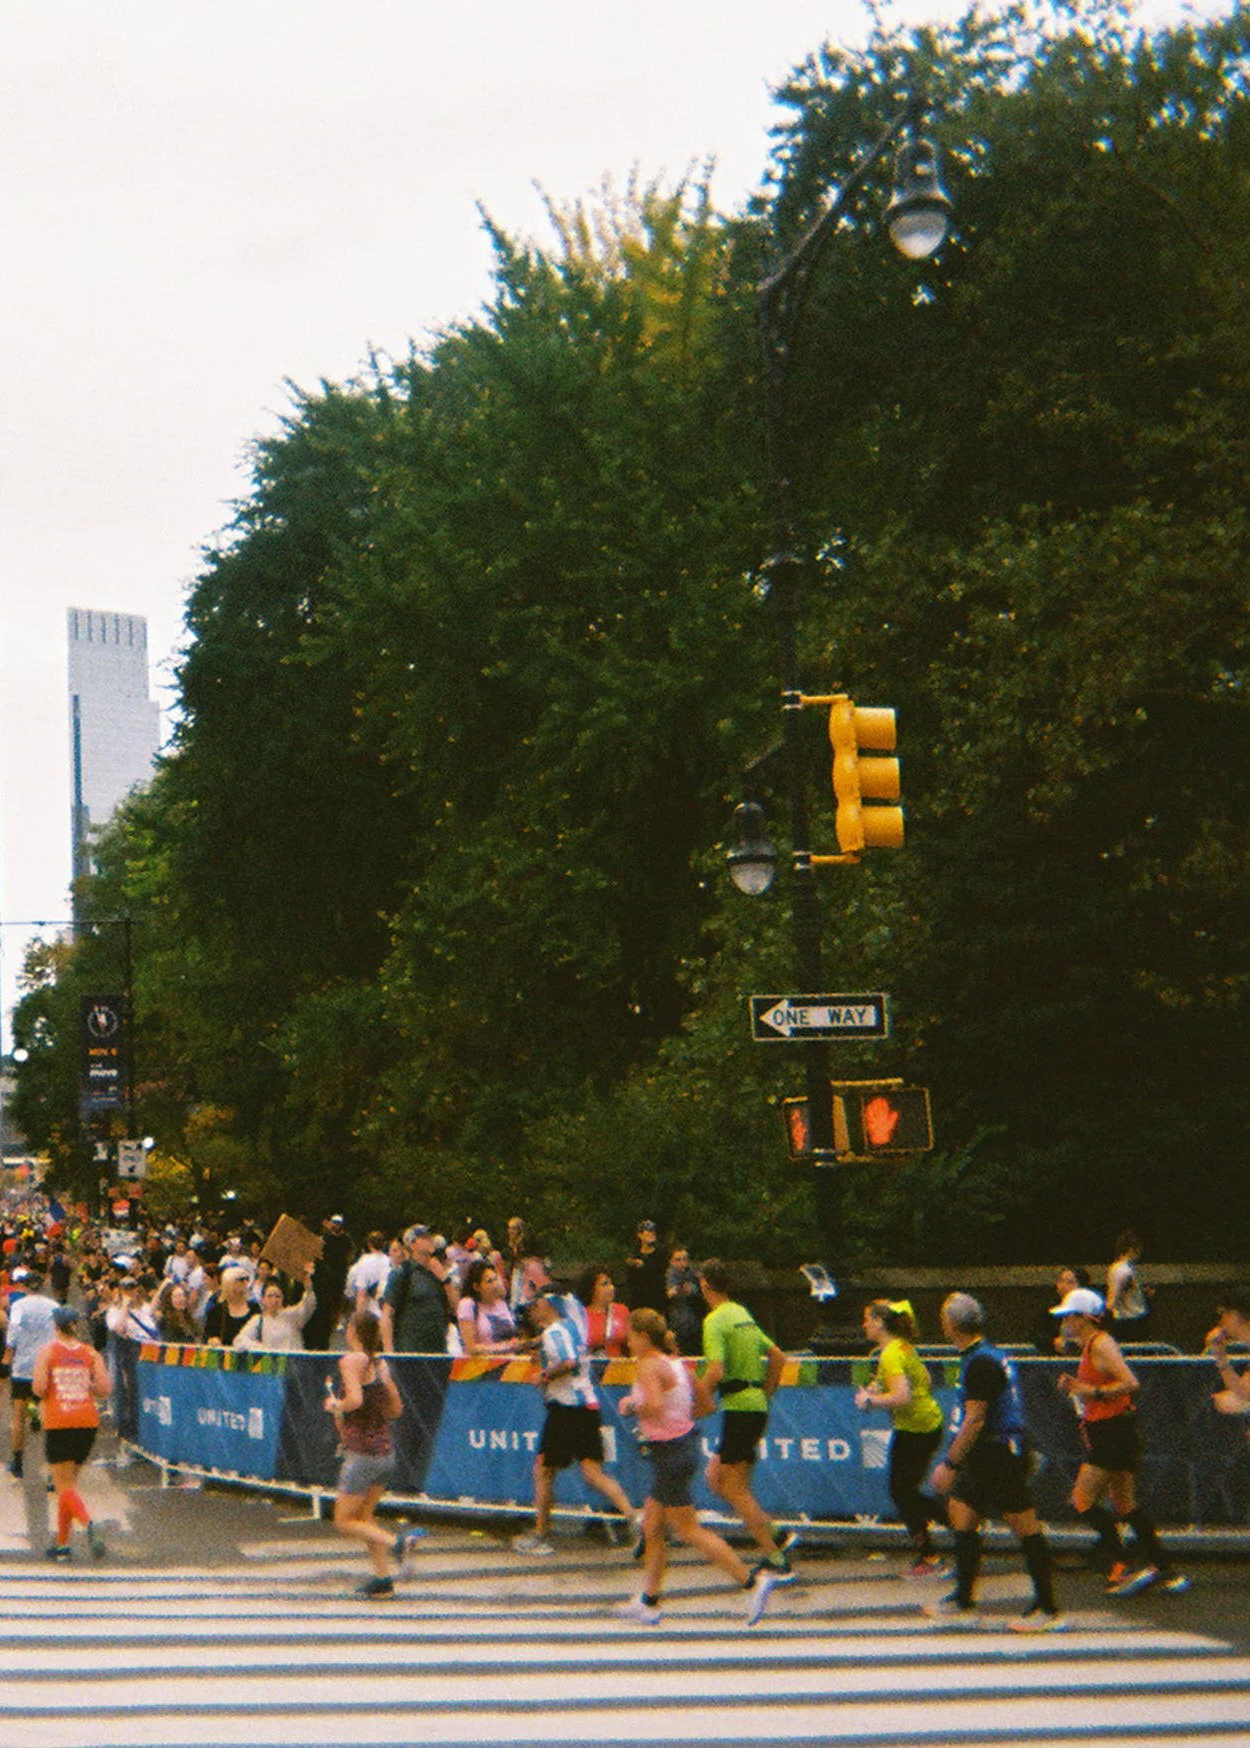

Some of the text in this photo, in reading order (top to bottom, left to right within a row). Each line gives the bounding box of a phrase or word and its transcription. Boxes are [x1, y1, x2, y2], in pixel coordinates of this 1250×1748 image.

[772, 1007, 867, 1026] ONE WAY
[197, 1407, 246, 1431] UNITED
[469, 1428, 539, 1452] UNIT
[701, 1436, 851, 1461] UITED
